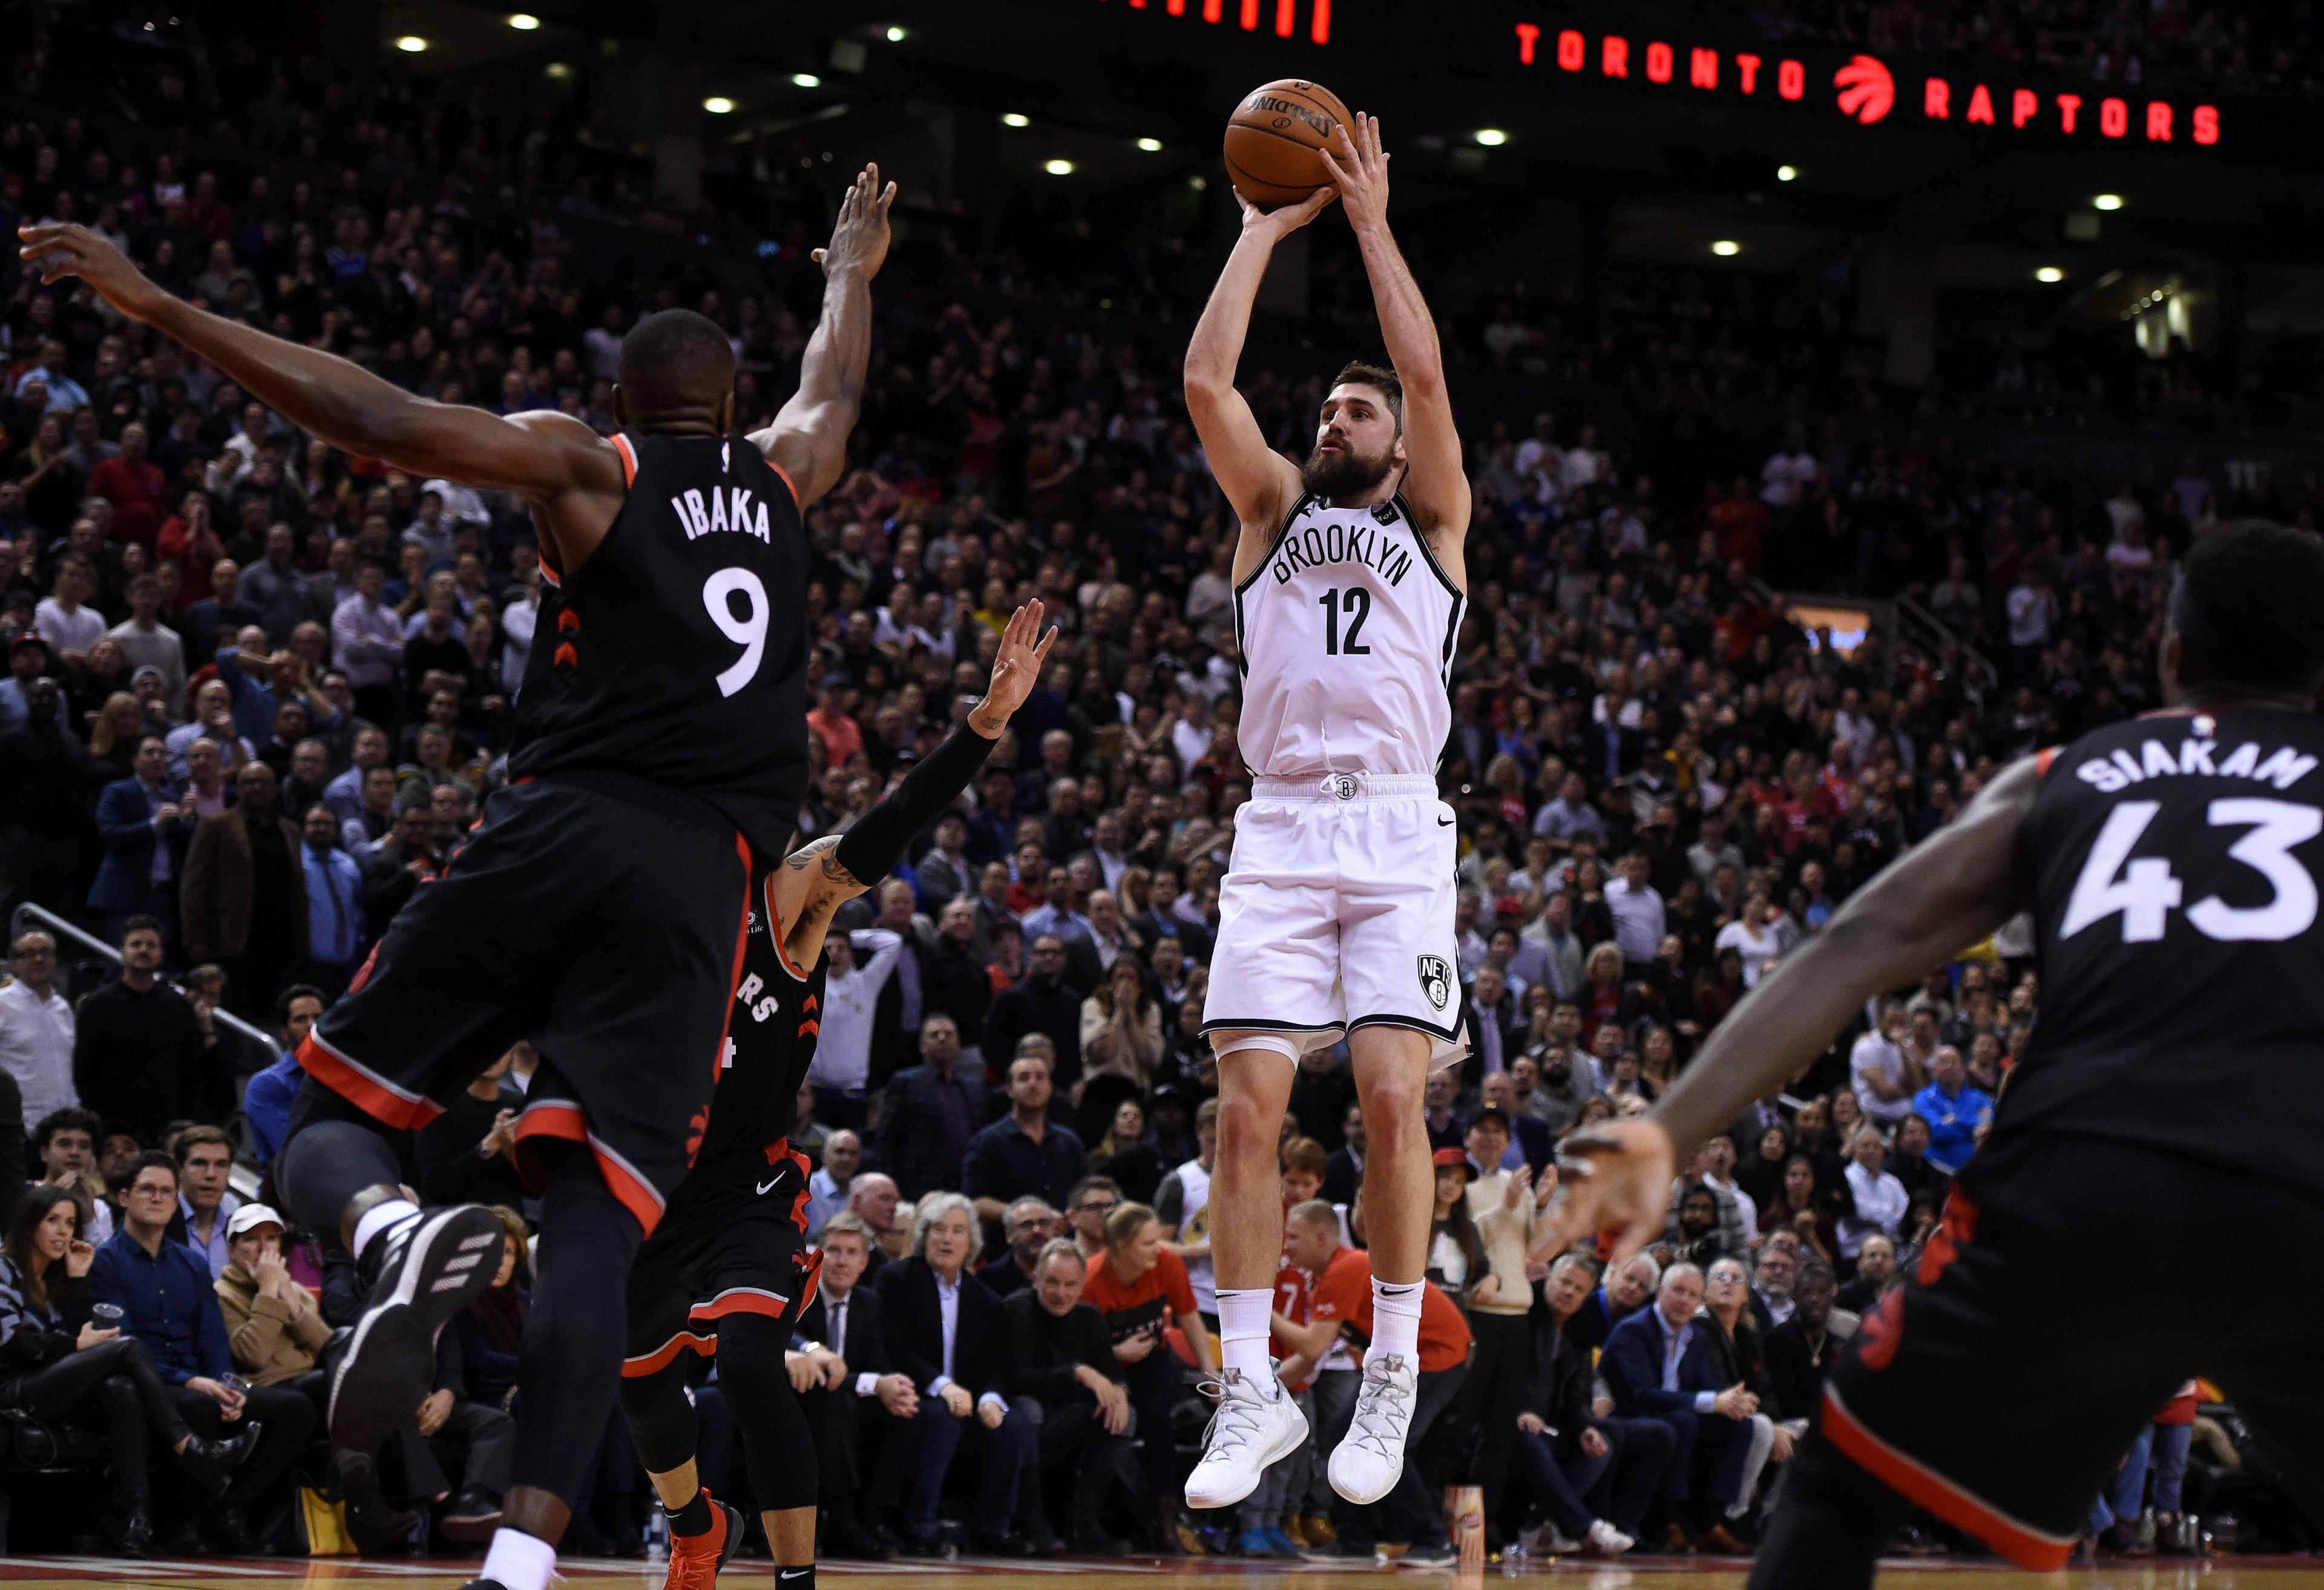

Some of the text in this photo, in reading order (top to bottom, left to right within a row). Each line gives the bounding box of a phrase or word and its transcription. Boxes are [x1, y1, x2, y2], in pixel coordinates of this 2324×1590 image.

[1515, 22, 2219, 145] TORONTO RAPTORS
[671, 485, 770, 544] IBAKA
[1273, 524, 1413, 588] BROOKLYN
[703, 567, 770, 697] 9
[1319, 586, 1371, 655] 12
[2076, 738, 2319, 793] SIAKAM
[2058, 796, 2323, 944] 43
[1422, 958, 1451, 991] NETS
